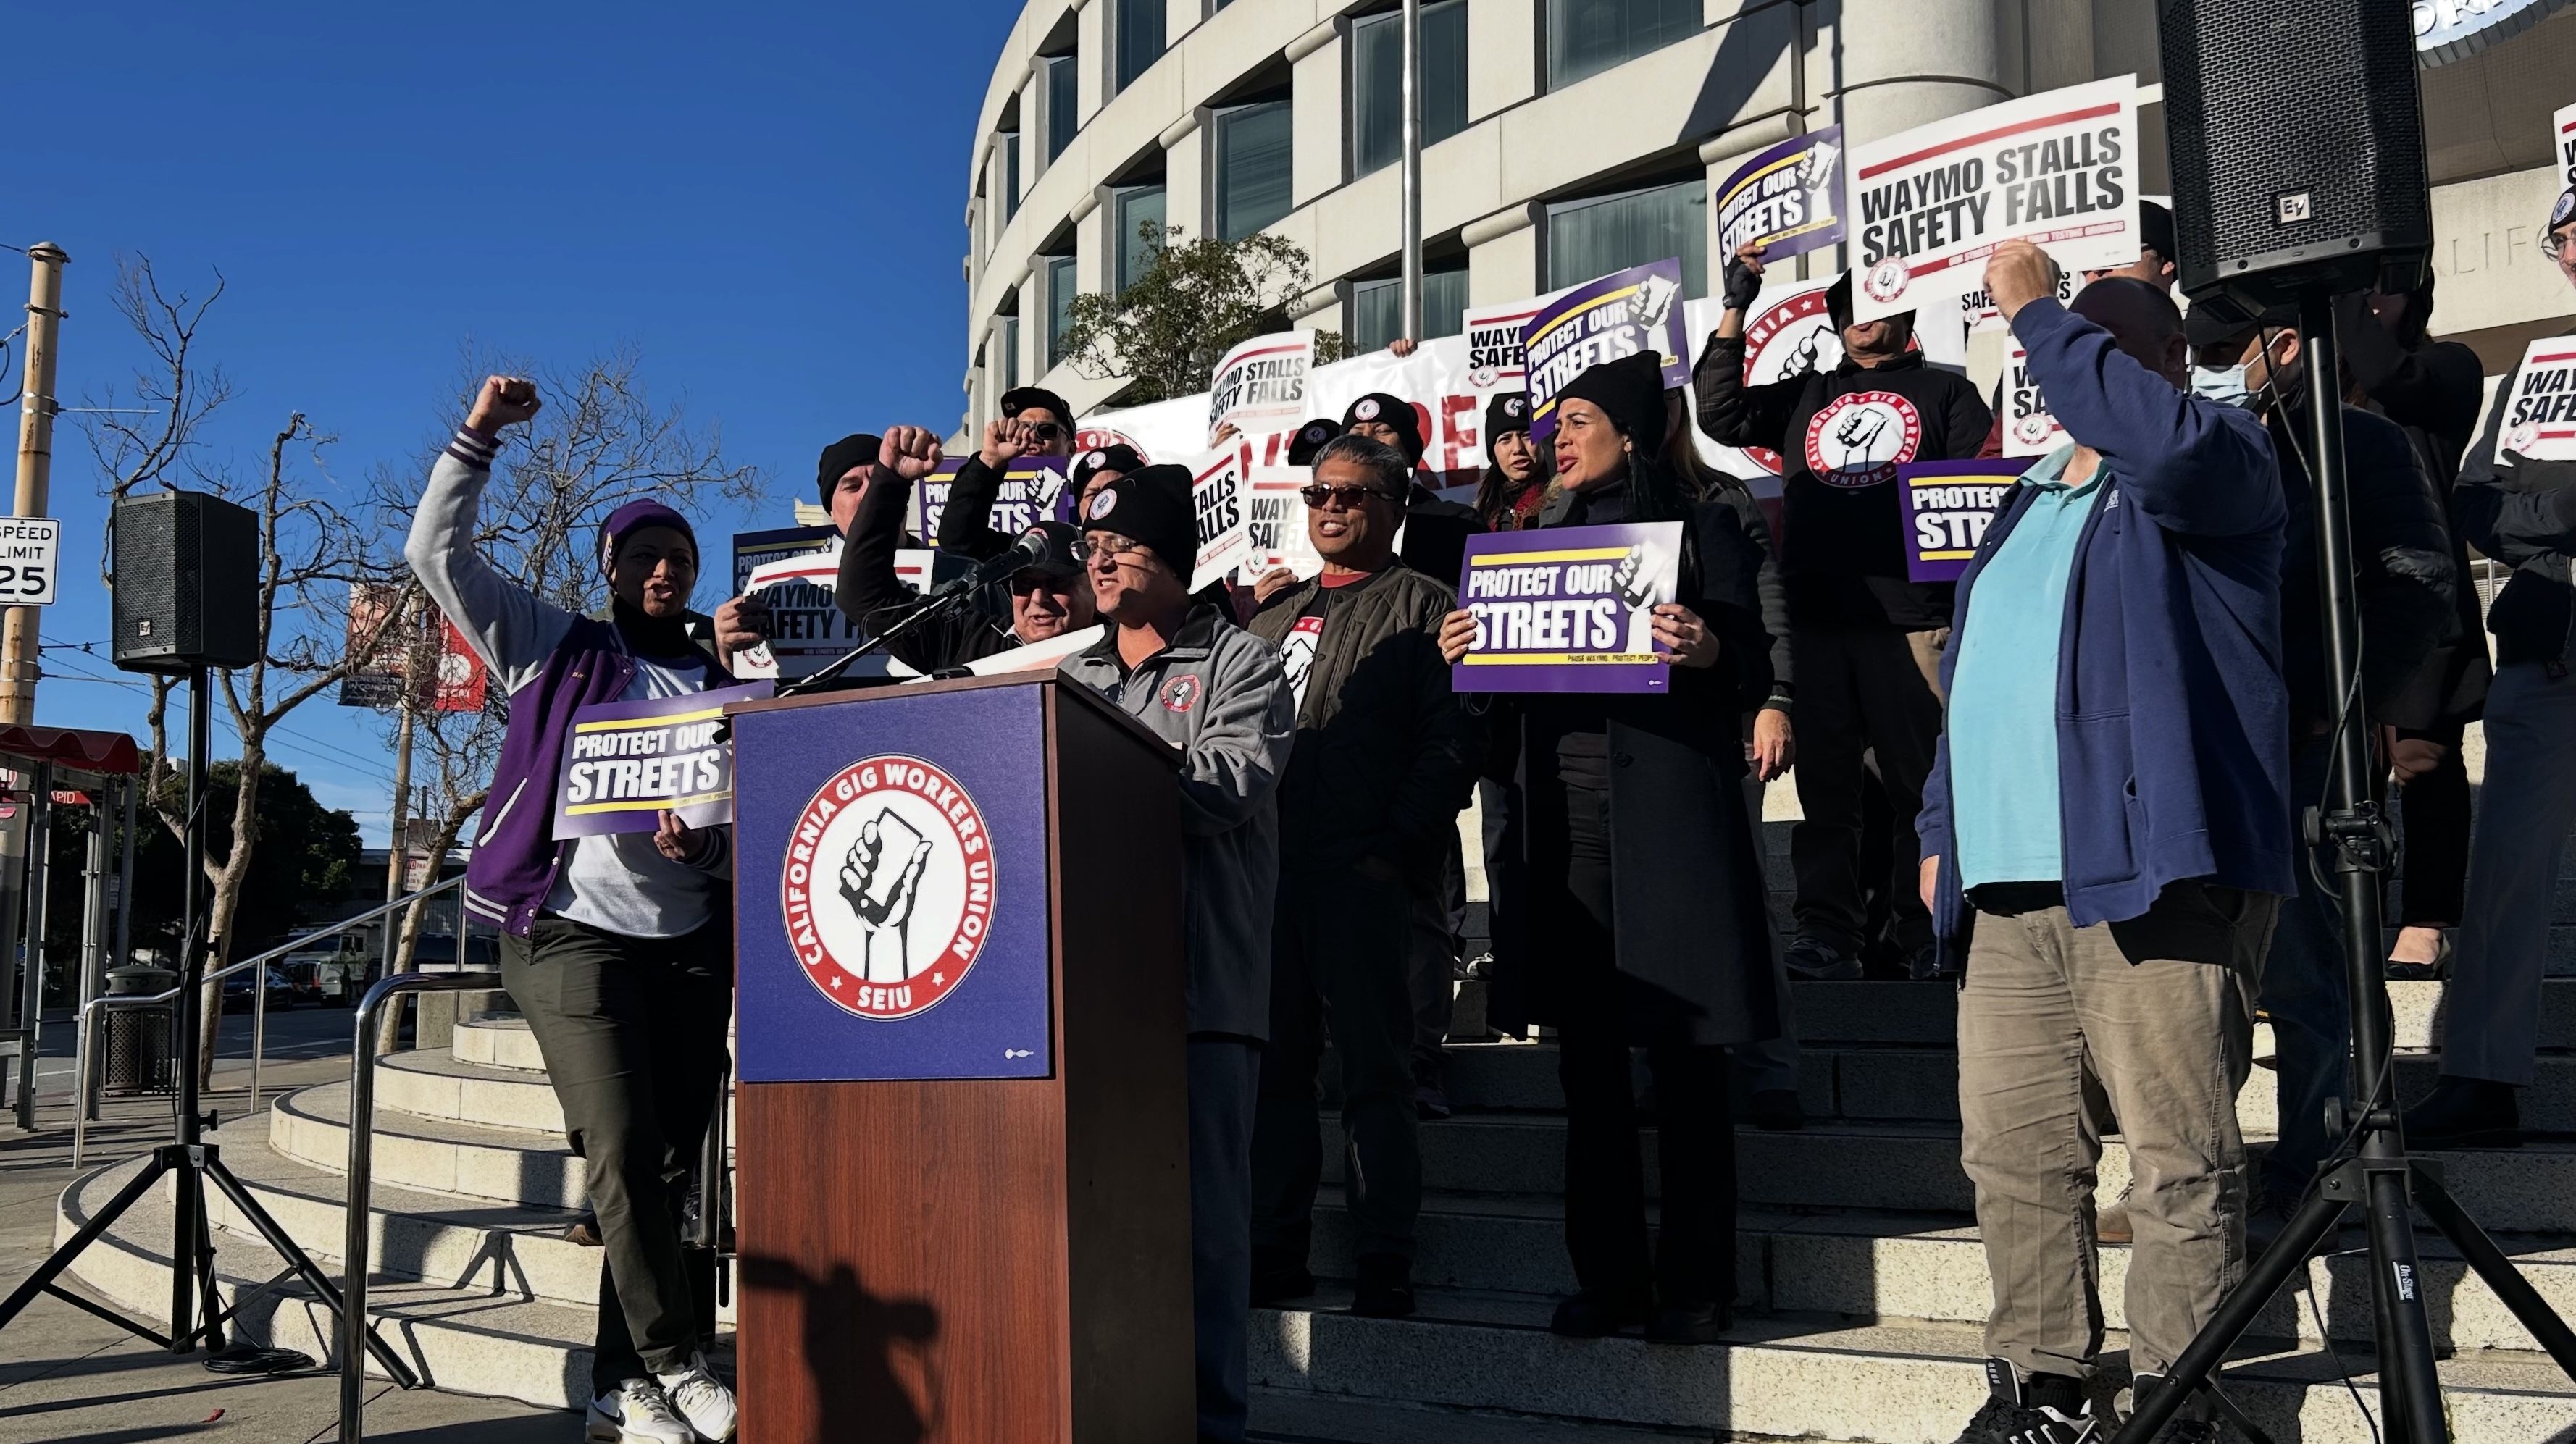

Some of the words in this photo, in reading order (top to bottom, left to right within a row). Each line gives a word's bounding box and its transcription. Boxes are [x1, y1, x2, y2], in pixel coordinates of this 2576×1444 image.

[1762, 167, 1797, 198] OUR
[1860, 157, 1983, 225] WAYMO
[1996, 127, 2121, 185] STALLS
[1721, 189, 1804, 267] STREETS
[1862, 191, 1991, 268] SAFETY
[2006, 166, 2124, 226] FALLS
[1470, 327, 1523, 348] WAY
[1527, 315, 1584, 373] PROTECT
[1588, 301, 1629, 333] OUR
[1245, 357, 1305, 382] STALLS
[1529, 324, 1639, 410] STREETS
[1246, 378, 1304, 405] FALLS
[1808, 393, 1854, 471] CALIFORNIA
[1869, 393, 1898, 404] GIG
[1830, 471, 1883, 485] UNION
[0, 565, 46, 595] 25
[1467, 566, 1561, 599] PROTECT
[1565, 564, 1613, 596] OUR
[1467, 597, 1618, 650] STREETS
[572, 729, 671, 760] PROTECT
[674, 721, 718, 752] OUR
[567, 748, 721, 803] STREETS
[788, 797, 838, 966] CALIFORNIA
[835, 766, 879, 802] GIG
[884, 763, 984, 855] WORKERS
[951, 860, 990, 961] UNION
[856, 985, 913, 1011] SEIU
[2399, 1264, 2414, 1301] On-Stage
